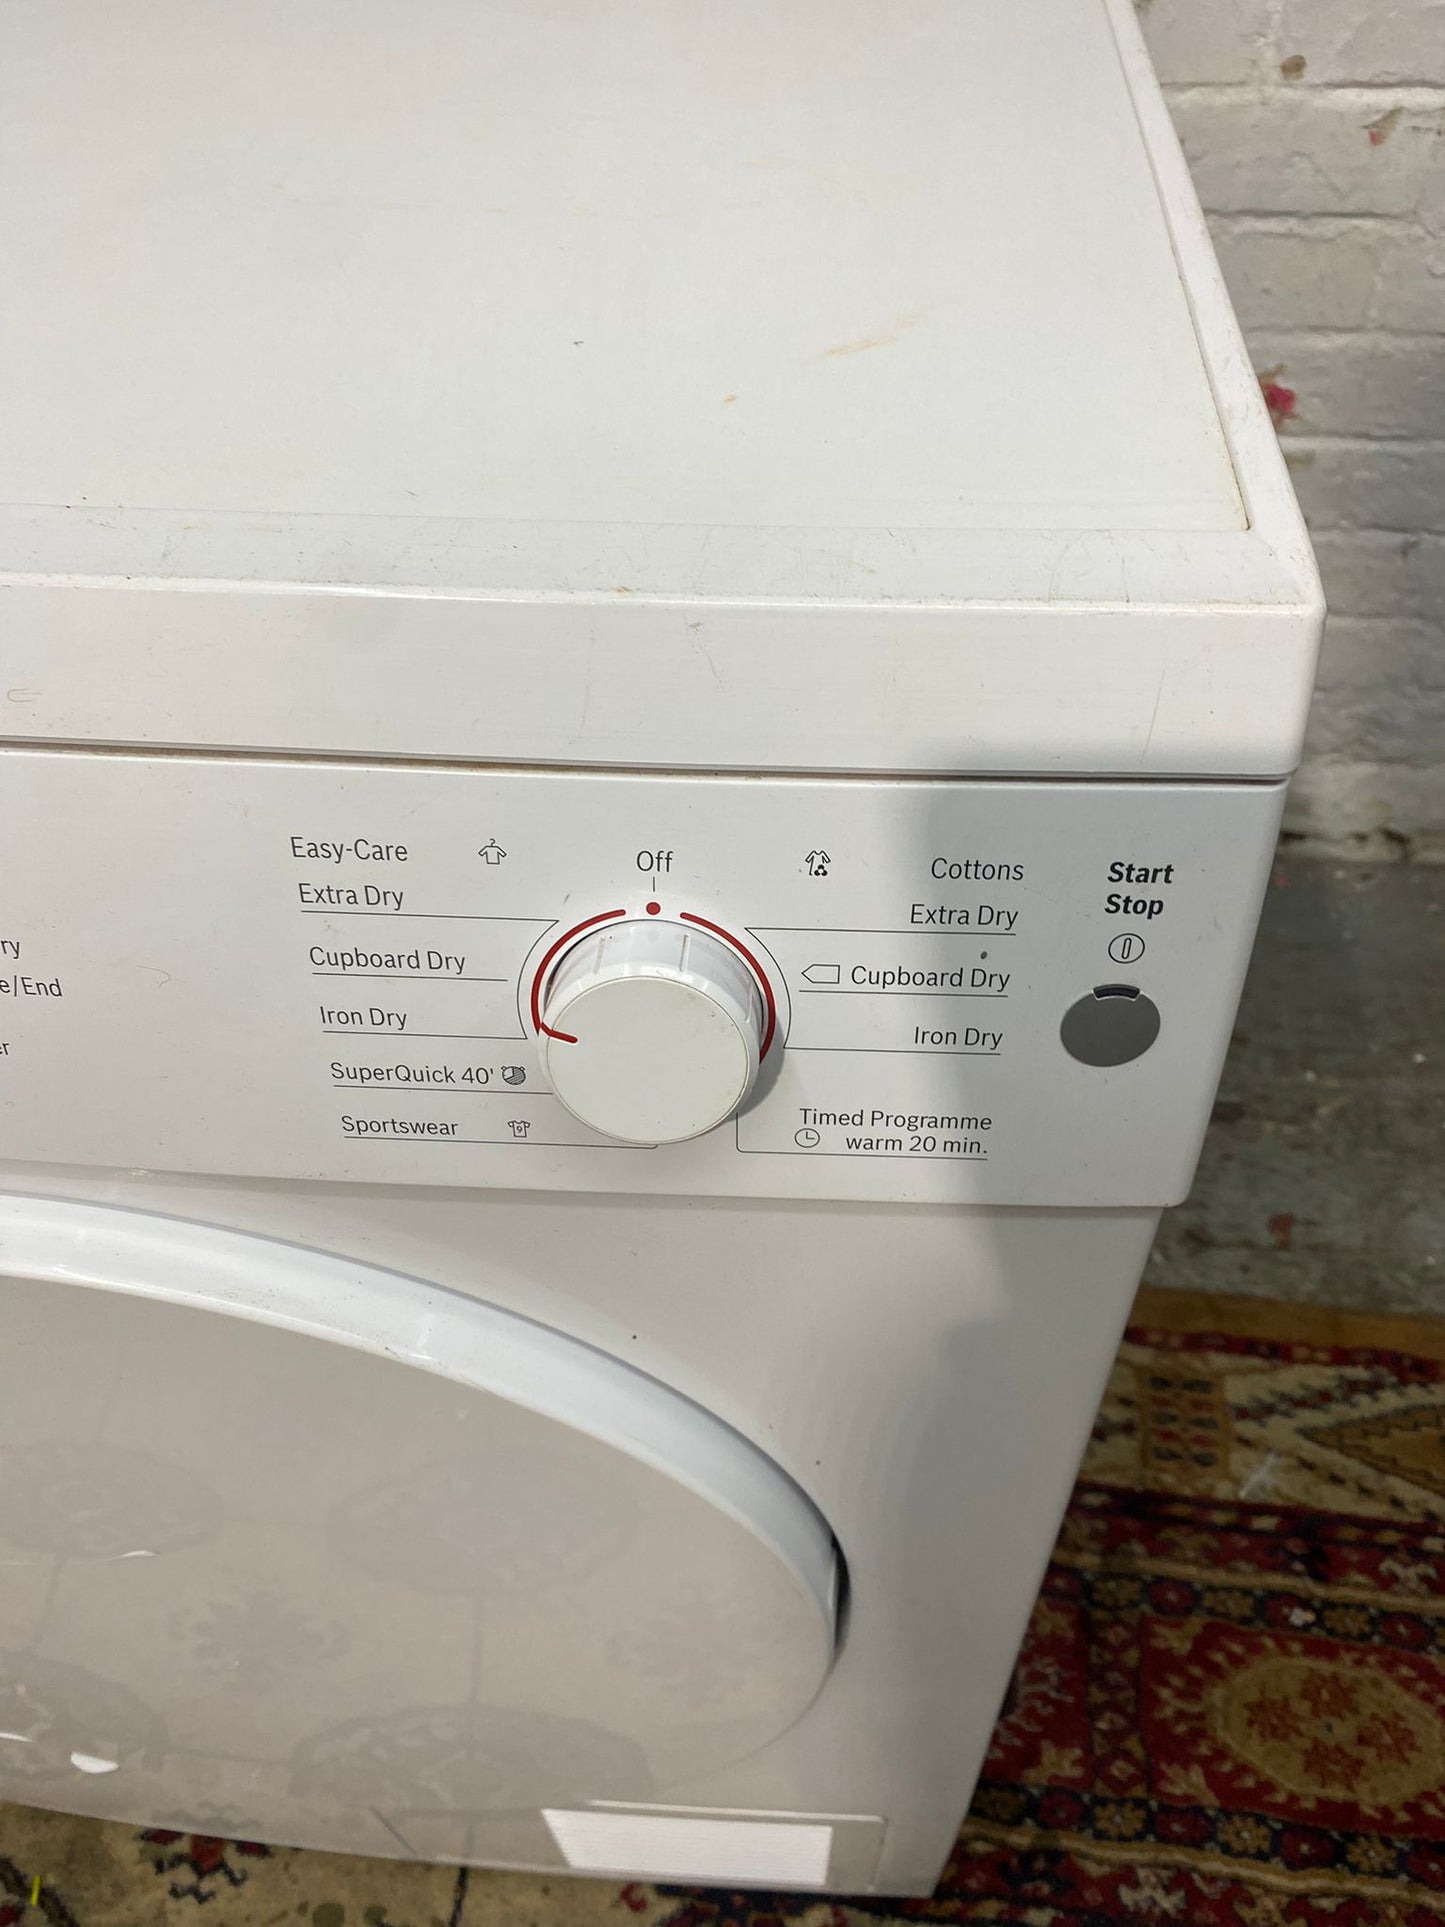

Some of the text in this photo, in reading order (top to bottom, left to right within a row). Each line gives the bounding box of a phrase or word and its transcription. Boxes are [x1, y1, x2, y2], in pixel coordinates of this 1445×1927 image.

[290, 836, 408, 864] Easy-Care
[636, 850, 674, 872] Off
[931, 857, 1024, 881] Cottons
[1107, 861, 1174, 884] Start
[298, 883, 404, 911] Extra Dry
[1104, 893, 1164, 920] Stop
[910, 903, 1019, 931] Extra Dry
[309, 946, 466, 975] Cupboard Dry
[851, 965, 1011, 992] Cupboard Dry
[319, 1005, 407, 1031] Iron Dry
[914, 1026, 1003, 1050] Iron Dry
[330, 1062, 494, 1085] SuperQuick 40'
[341, 1115, 459, 1136] Sportswear
[799, 1108, 993, 1132] Timed Programme
[846, 1135, 988, 1154] warm 20 min.
